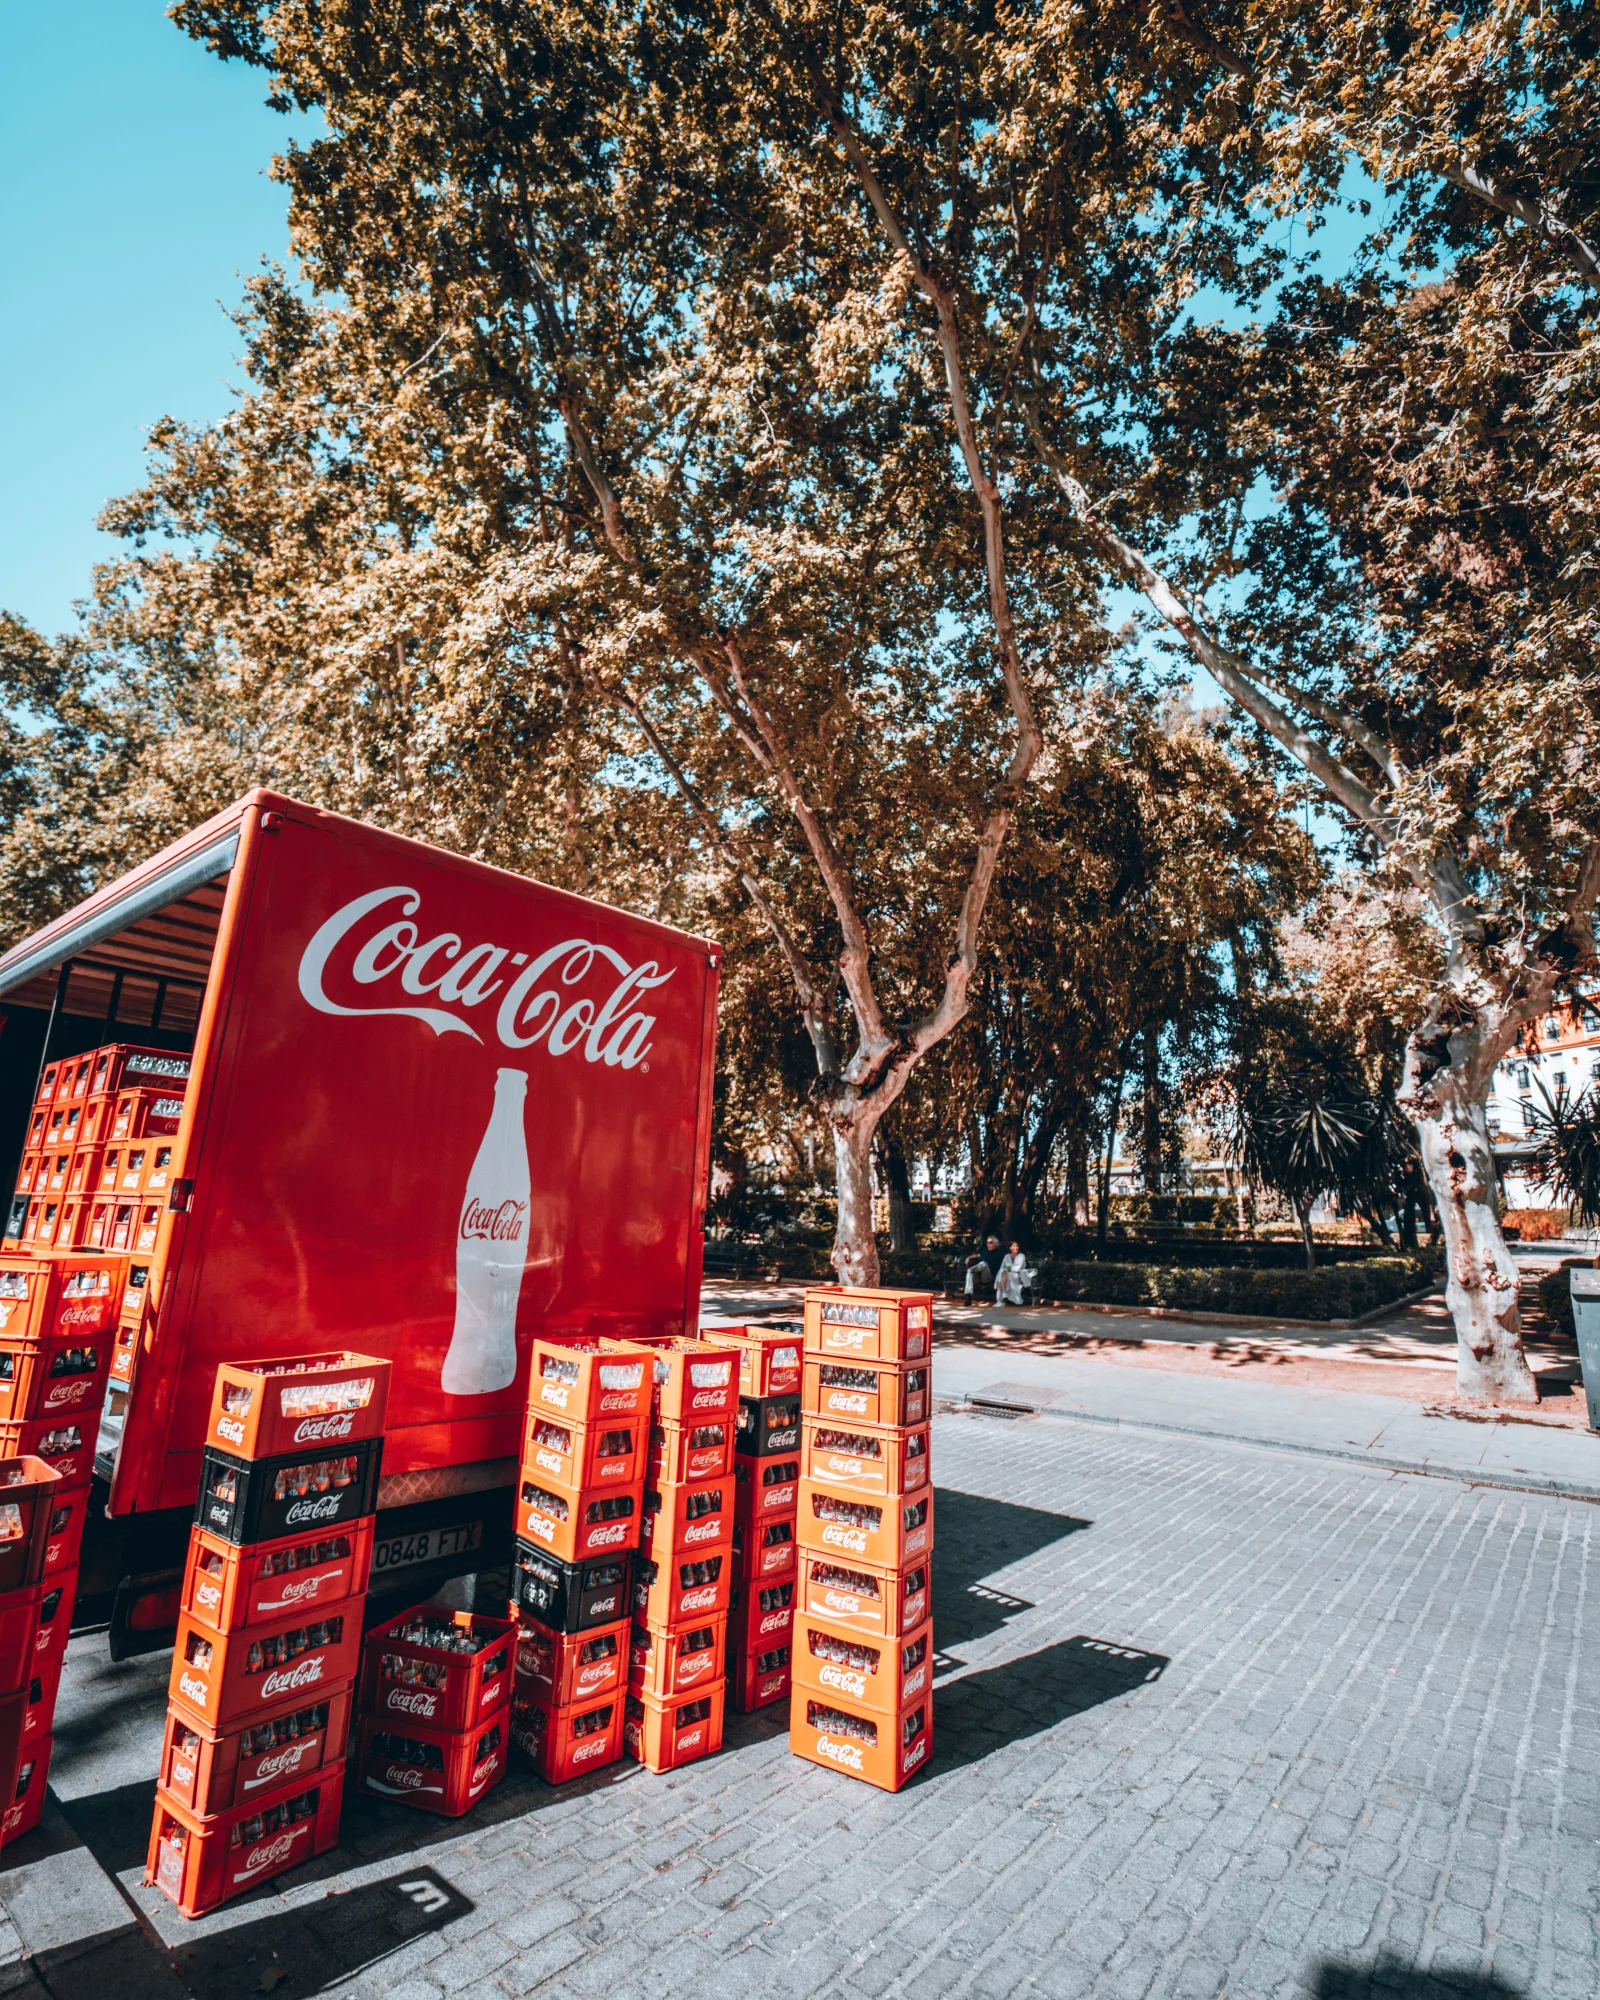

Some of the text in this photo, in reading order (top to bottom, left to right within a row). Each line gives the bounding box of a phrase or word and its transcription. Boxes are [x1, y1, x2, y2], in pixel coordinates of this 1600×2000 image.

[298, 886, 677, 1070] Coca-Cola
[460, 1197, 527, 1241] Coca-Cola
[61, 1305, 104, 1325] Coca-Cola
[50, 1381, 87, 1401] Coca-Cola
[600, 1392, 638, 1410] Coca-Cola
[692, 1389, 728, 1409] Coca-Cola
[294, 1412, 355, 1443] Coca-Cola
[767, 1429, 797, 1449] Coca-Cola
[691, 1450, 721, 1467] Coca-Cola
[828, 1455, 863, 1474] Coca-Cola
[286, 1492, 344, 1524] Coca-Cola
[587, 1523, 628, 1548] Coca-Cola
[684, 1519, 721, 1543] Coca-Cola
[822, 1524, 868, 1553] Coca-Cola
[376, 1523, 478, 1568] 0848 FTX
[282, 1575, 320, 1599] Coca-Cola
[680, 1586, 719, 1612] Coca-Cola
[825, 1591, 860, 1613] Coca-Cola
[580, 1661, 613, 1683] Coca-Cola
[679, 1652, 710, 1674] Coca-Cola
[261, 1655, 325, 1698] Coca-Cola
[819, 1664, 867, 1697] Coca-Cola
[387, 1688, 438, 1717] Coca-Cola
[256, 1742, 306, 1777] Coca-Cola
[573, 1737, 607, 1764] Coca-Cola
[817, 1735, 864, 1770] Coca-Cola
[386, 1766, 424, 1787] Coca-Cola
[246, 1831, 295, 1869] Coca-Cola
